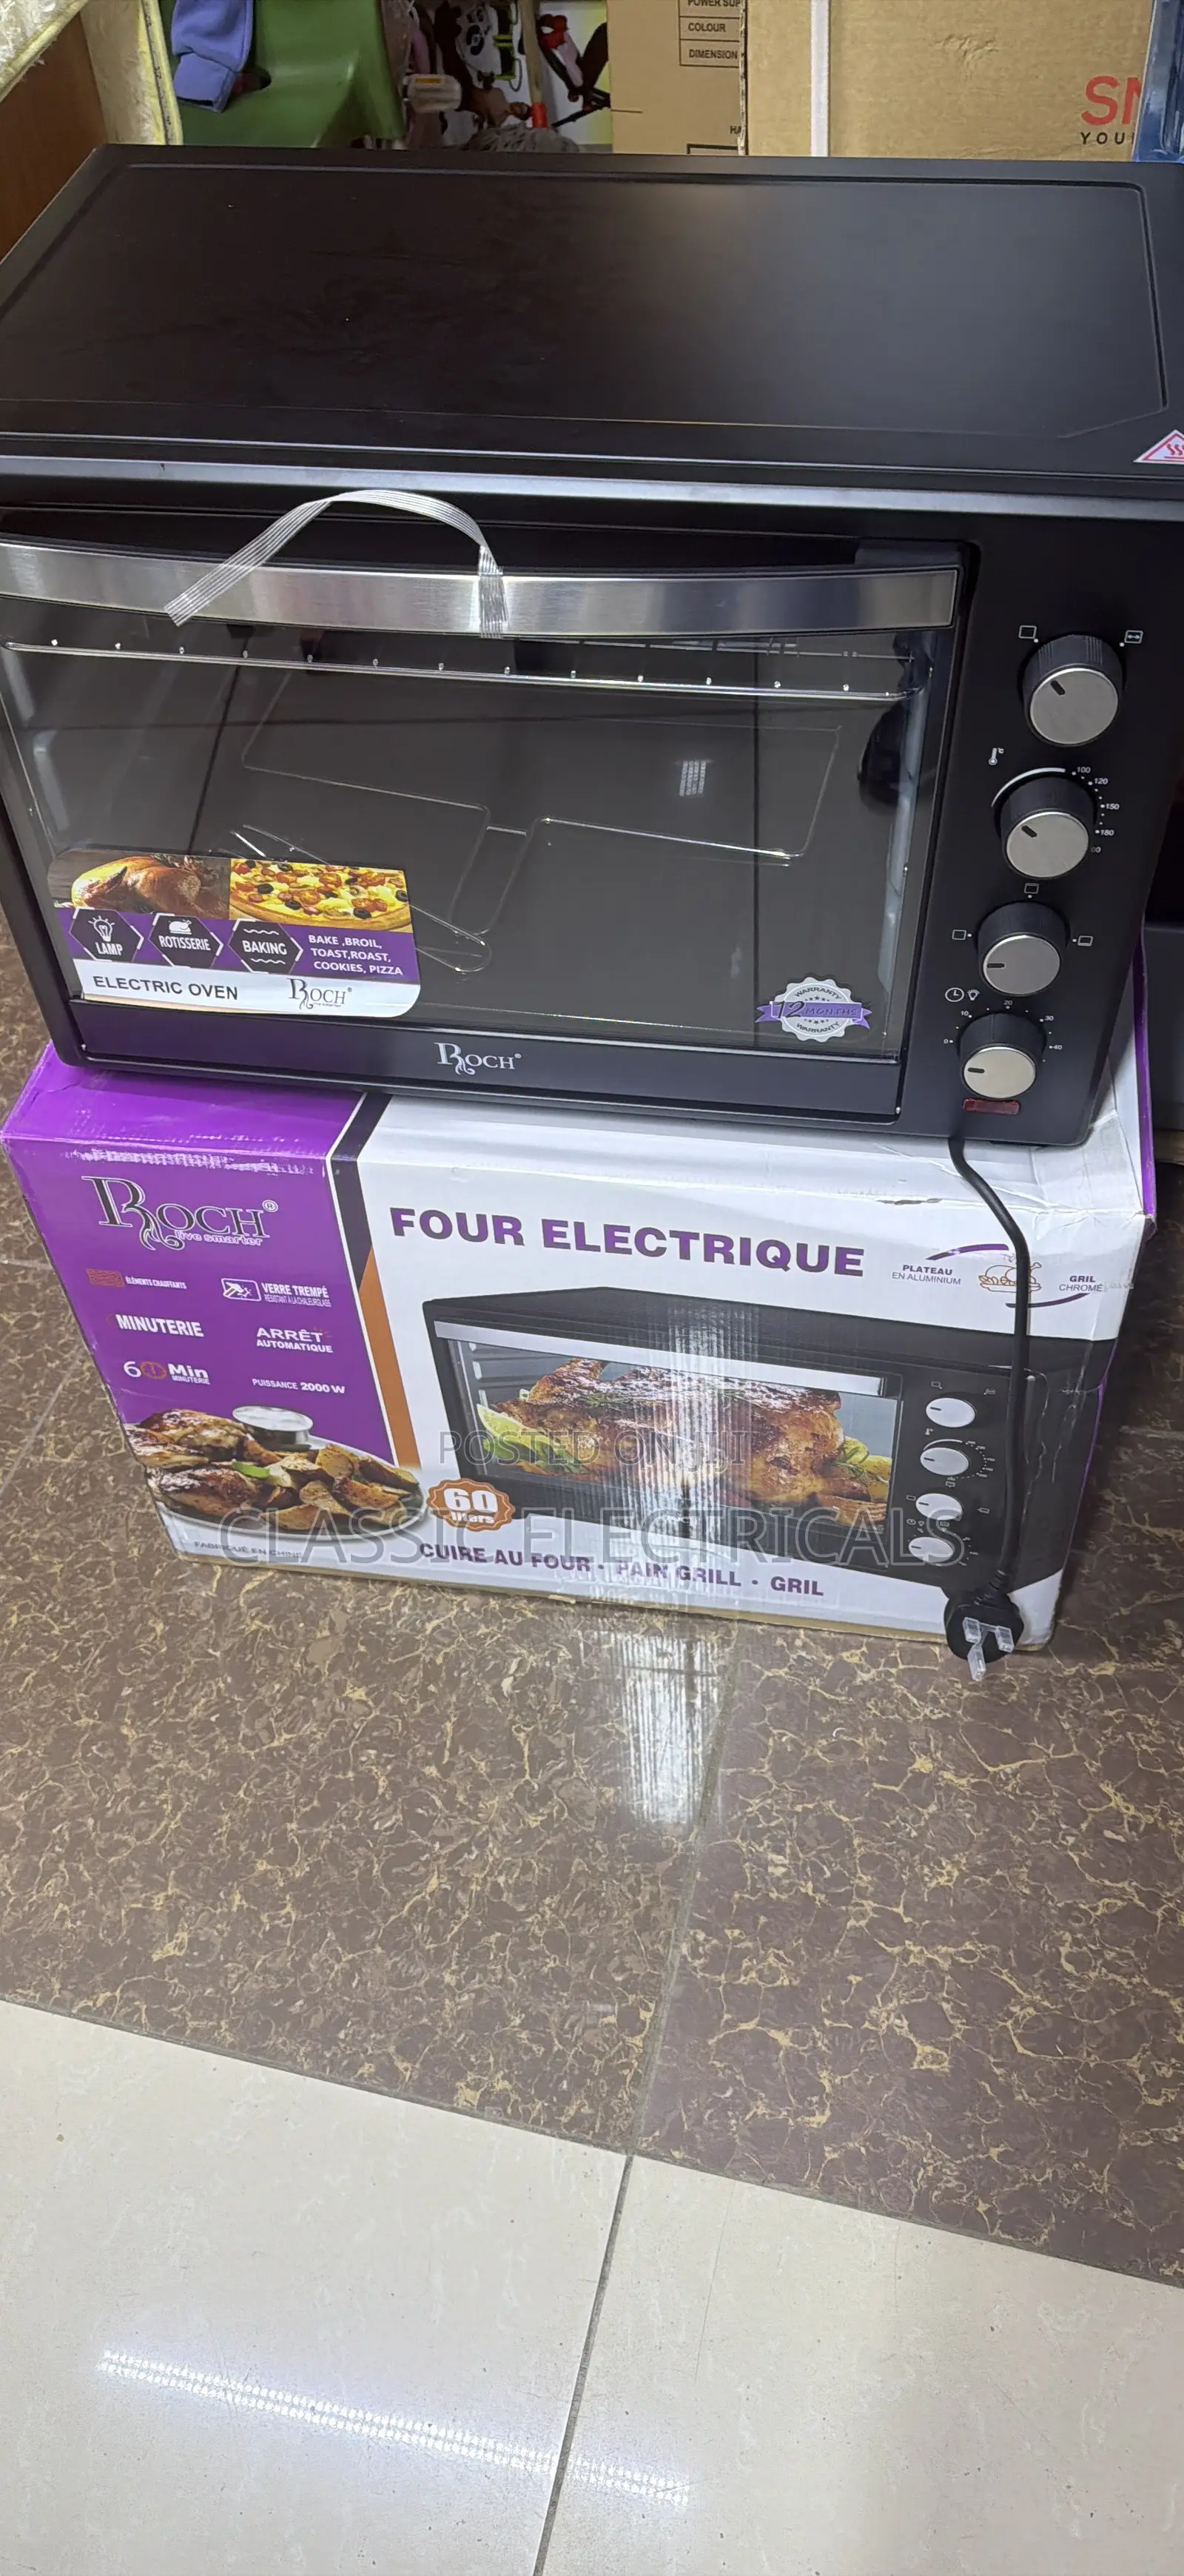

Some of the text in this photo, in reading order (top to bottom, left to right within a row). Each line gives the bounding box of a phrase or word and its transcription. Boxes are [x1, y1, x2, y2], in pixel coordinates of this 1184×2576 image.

[688, 22, 726, 33] COLOUR
[689, 49, 738, 59] DIMENSION
[1077, 766, 1092, 774] 100
[1094, 777, 1109, 785] 120
[158, 935, 211, 952] ROTISSERIE
[242, 940, 288, 955] BAKING
[308, 935, 339, 946] BAKE
[95, 941, 124, 955] LAMP
[313, 961, 403, 976] COOKIES, PIZZA
[92, 975, 238, 1001] ELECTRIC OVEN
[795, 986, 842, 1000] WARRANTY
[776, 1001, 858, 1019] 12 MONTHS
[796, 1021, 841, 1034] WARRANTY
[175, 1229, 263, 1246] live smarter
[389, 1206, 864, 1277] FOUR ELECTRIQUE
[902, 1264, 953, 1276] PLATEAU
[892, 1271, 961, 1285] EN ALUMINIUM
[1069, 1275, 1096, 1283] GRIL
[261, 1282, 329, 1299] VERRE TREMPÉ
[1059, 1282, 1103, 1292] CHROMÉ
[115, 1314, 204, 1337] MINUTERIE
[257, 1327, 323, 1343] ARRÊT
[257, 1339, 333, 1353] AUTOMATIQUE
[167, 1362, 209, 1378] Min
[172, 1375, 210, 1385] MINUTERIE
[252, 1378, 346, 1394] PUISSANCE 2000 W
[444, 1487, 499, 1513] 60
[420, 1543, 488, 1564] CUIRE
[494, 1549, 523, 1567] AU
[532, 1553, 591, 1572] FOUR
[676, 1564, 742, 1587] GRILL
[770, 1575, 824, 1597] GRIL
